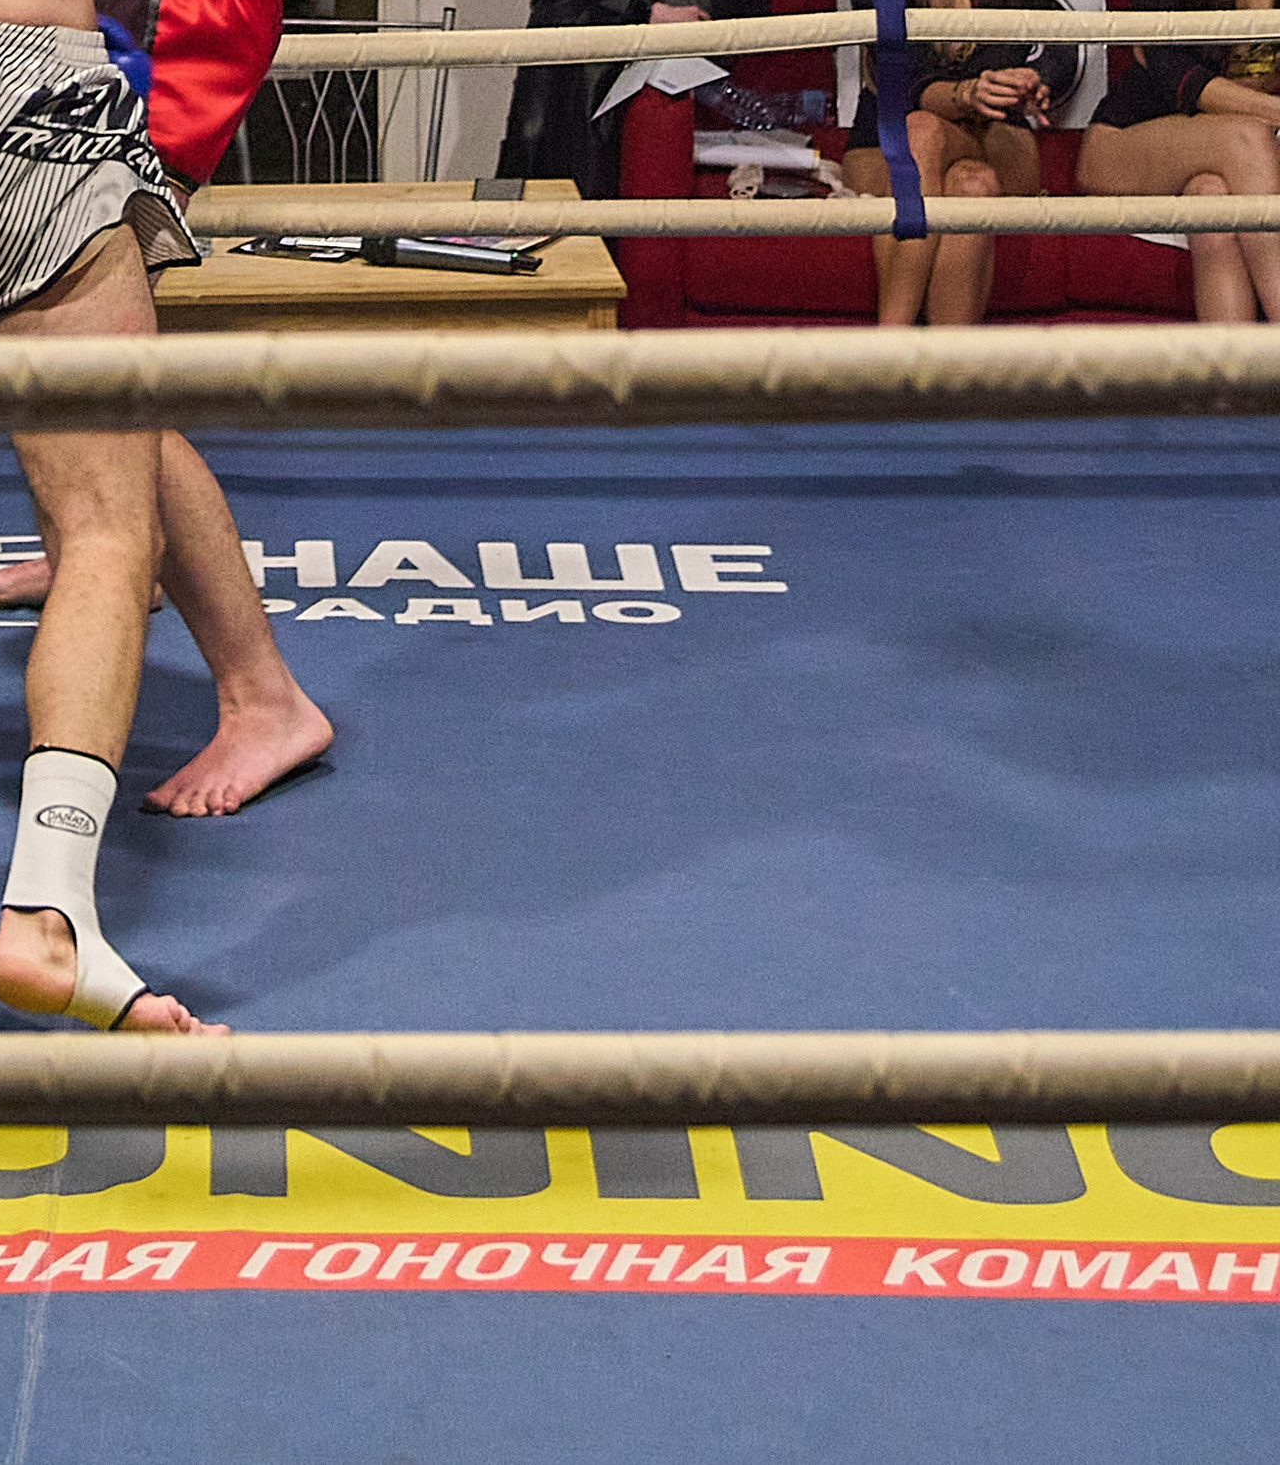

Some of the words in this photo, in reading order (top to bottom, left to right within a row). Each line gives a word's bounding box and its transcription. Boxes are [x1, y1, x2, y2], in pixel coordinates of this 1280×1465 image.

[240, 539, 788, 593] НАШЕ
[236, 1240, 832, 1285] ГОНОЧНАЯ
[882, 1246, 1280, 1292] КОМАН
